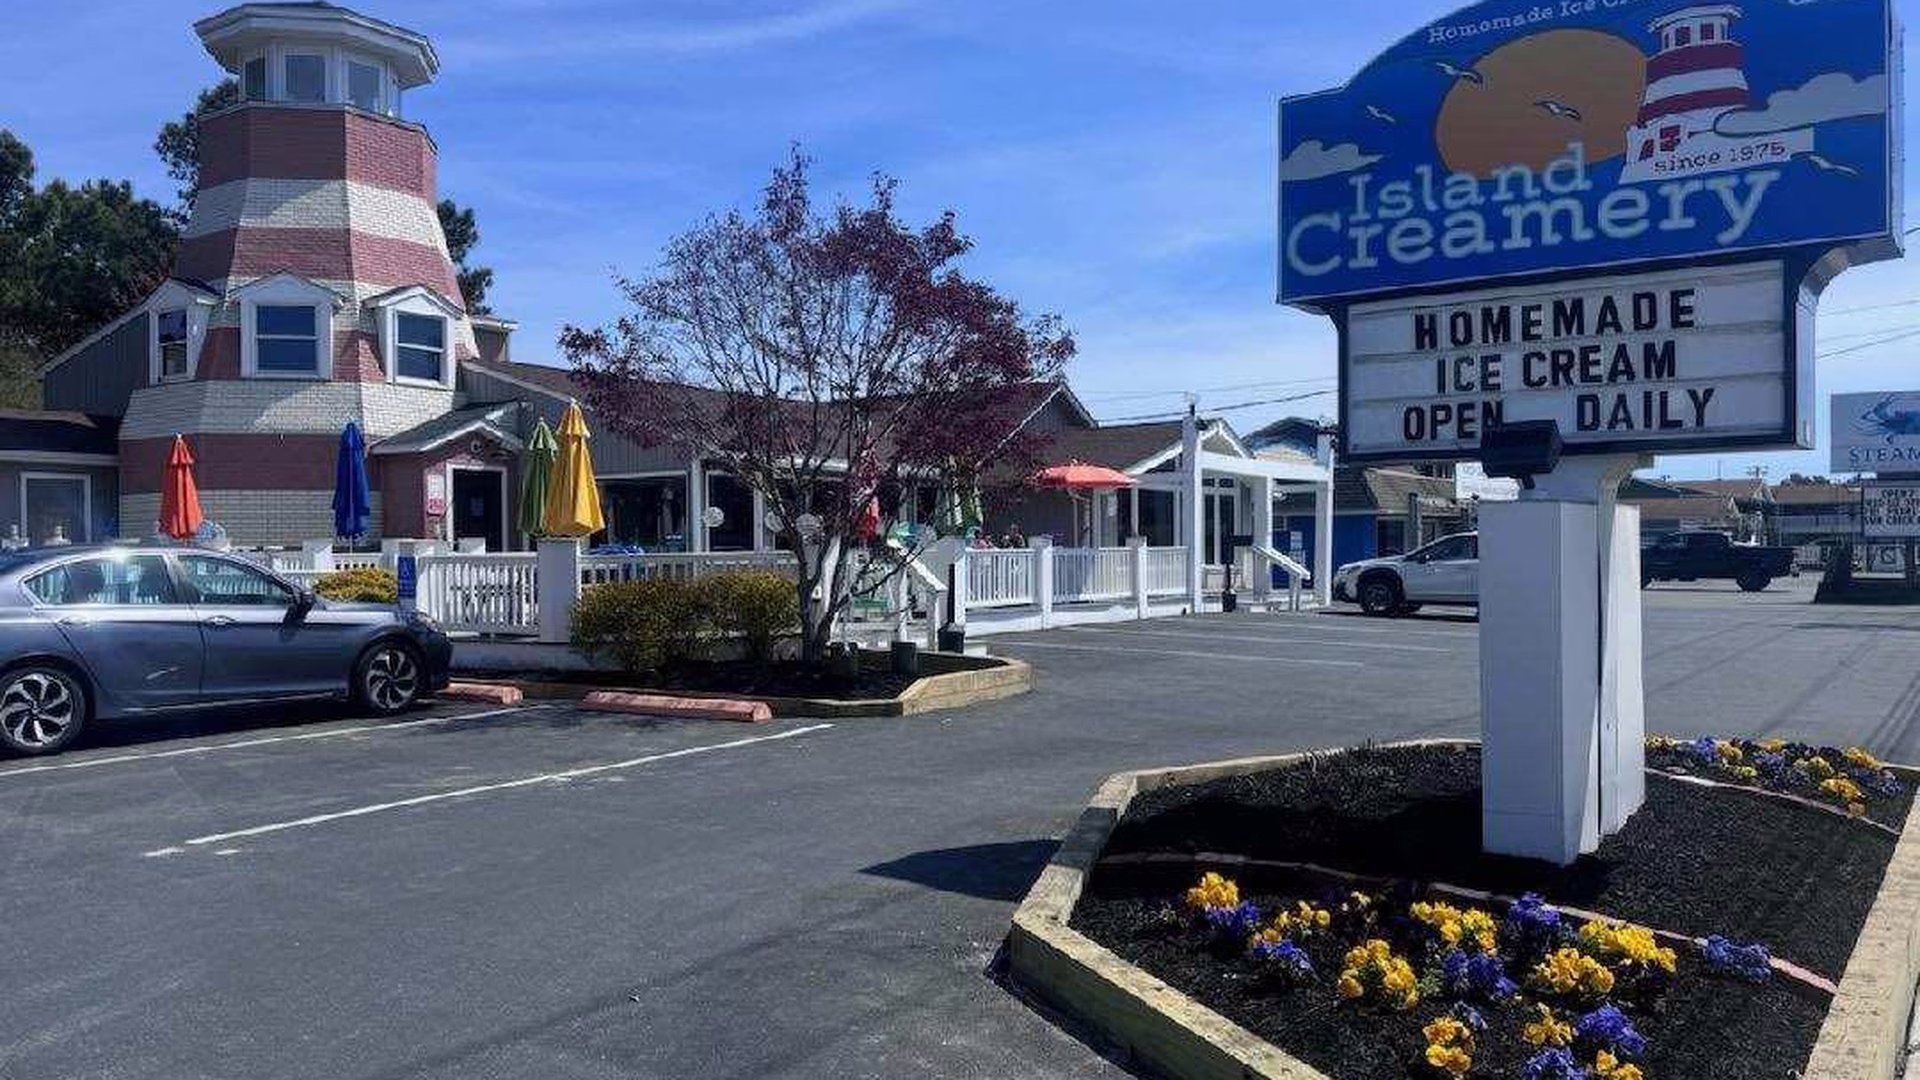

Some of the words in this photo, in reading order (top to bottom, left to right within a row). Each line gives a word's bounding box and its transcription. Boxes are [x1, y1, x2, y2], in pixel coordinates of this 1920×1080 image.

[1427, 6, 1554, 44] Homemade
[1559, 0, 1597, 18] Ice
[1348, 142, 1593, 223] Island
[1654, 151, 1721, 173] since
[1730, 141, 1786, 163] 1975
[1286, 167, 1780, 276] Creamery
[1414, 288, 1697, 351] HOMEMADE
[1437, 353, 1501, 395] ICE
[1522, 340, 1677, 389] CREAM
[1402, 400, 1503, 442] OPEN
[1576, 388, 1715, 432] DAILY
